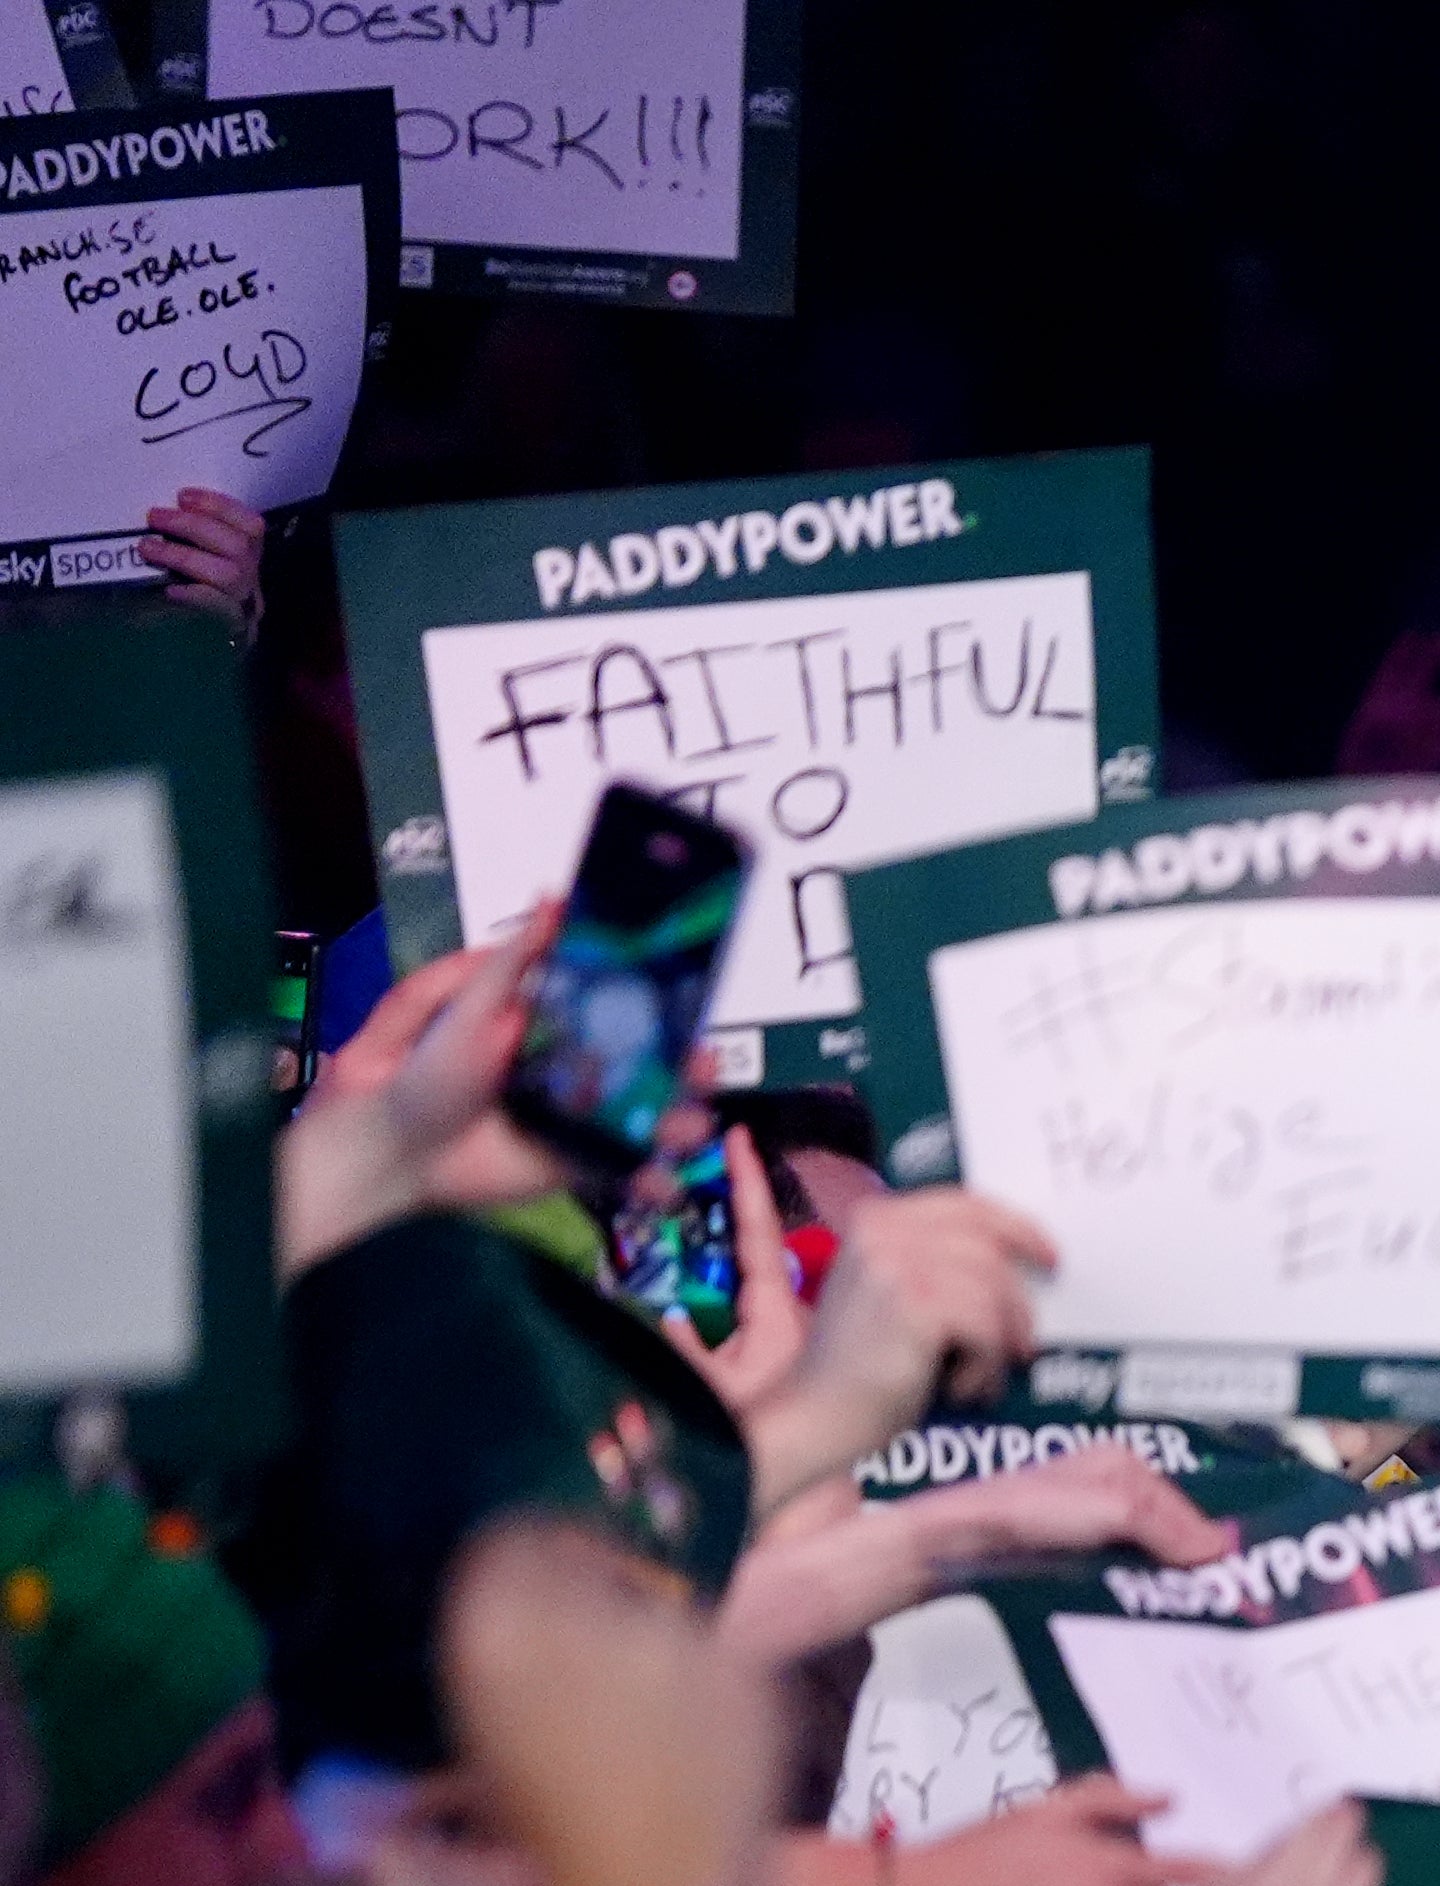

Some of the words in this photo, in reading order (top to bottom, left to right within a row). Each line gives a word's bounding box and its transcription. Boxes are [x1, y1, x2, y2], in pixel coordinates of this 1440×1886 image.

[0, 110, 277, 199] ADDYPOWER
[396, 96, 714, 198] ORK!!!
[57, 545, 147, 578] sport
[479, 618, 1088, 781] FAITHFUL
